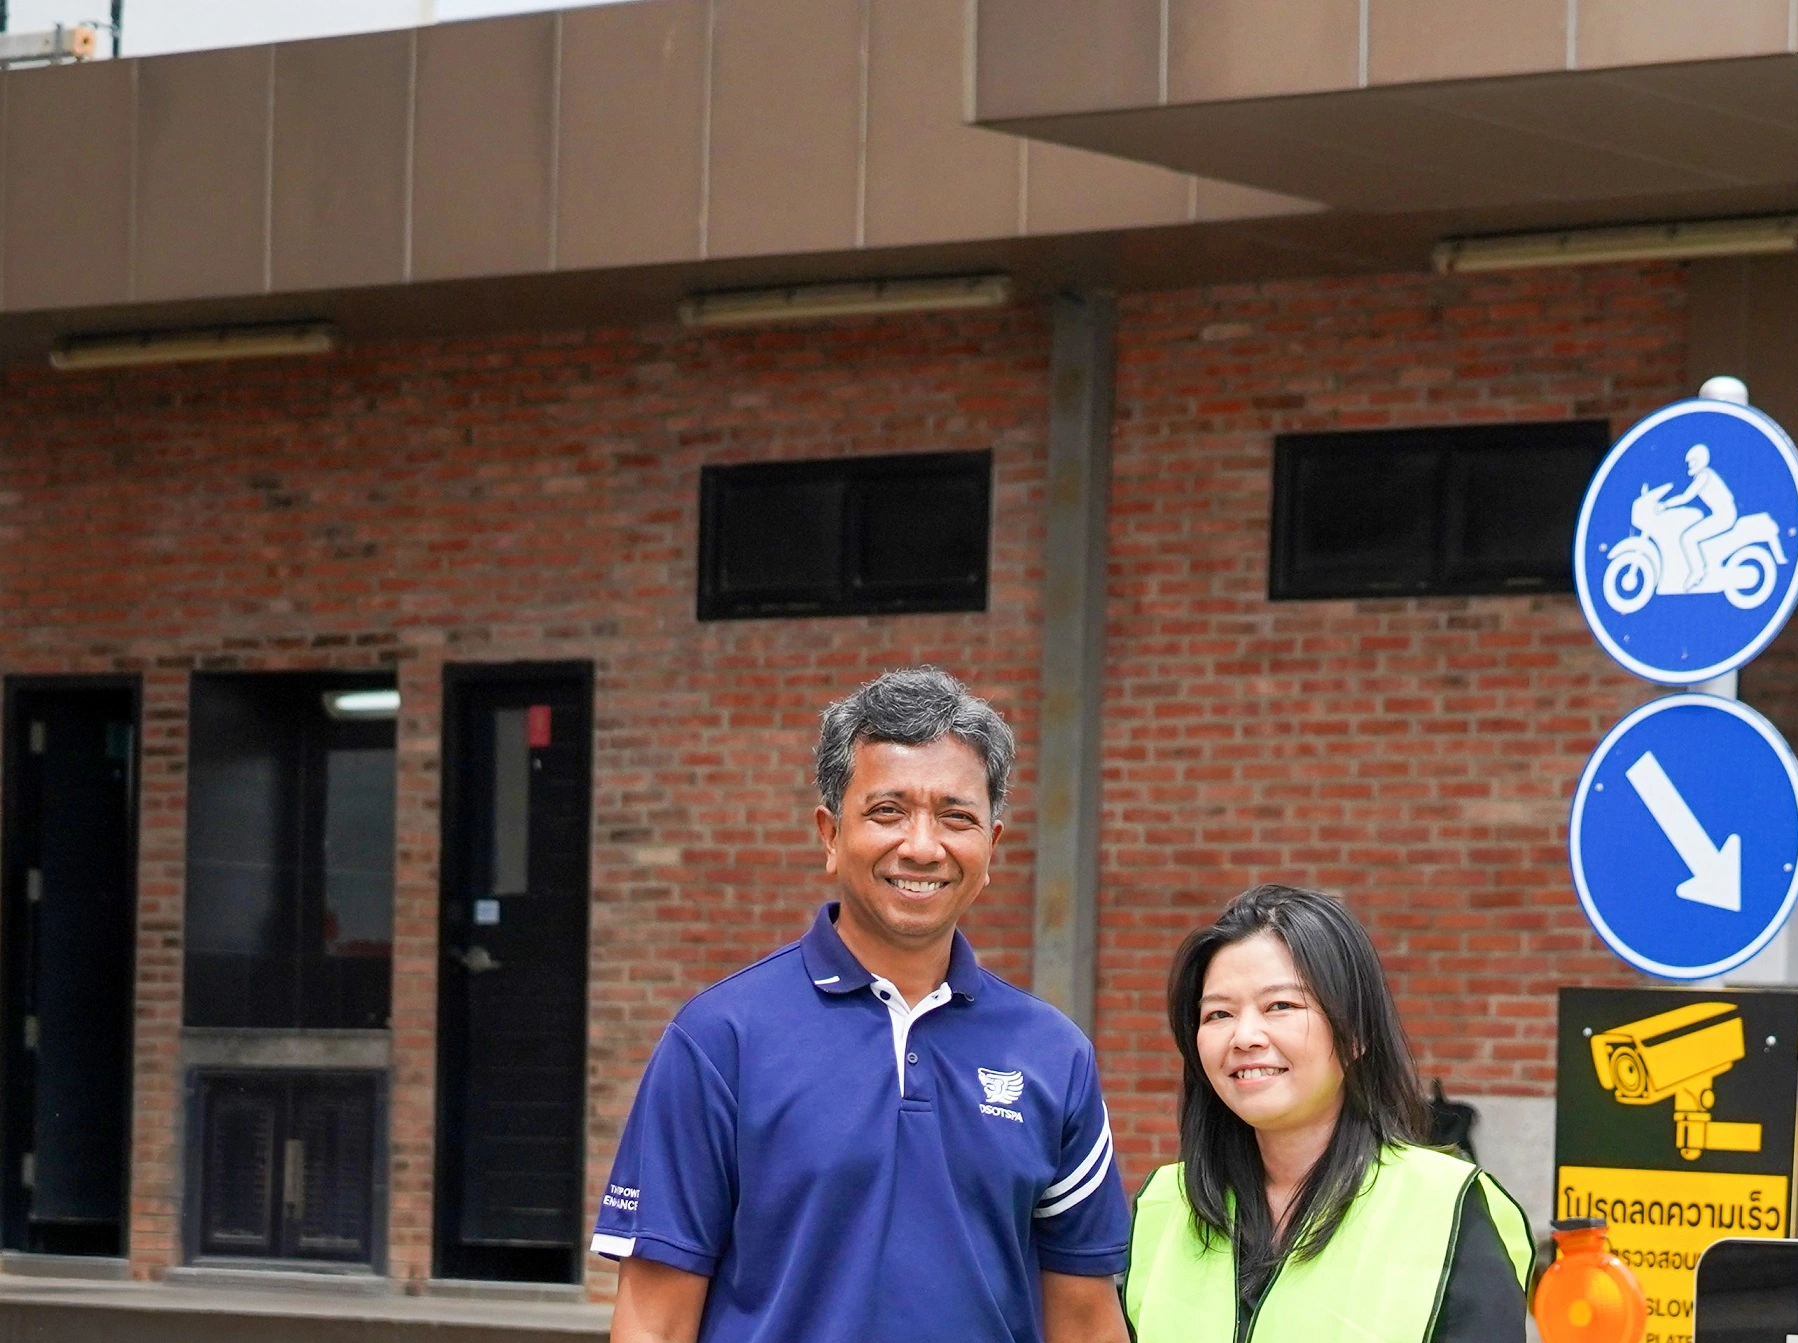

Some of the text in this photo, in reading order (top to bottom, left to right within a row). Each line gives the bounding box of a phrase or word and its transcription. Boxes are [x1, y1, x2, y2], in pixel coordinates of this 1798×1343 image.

[1564, 1186, 1780, 1231] โปรดลดความเร็ว
